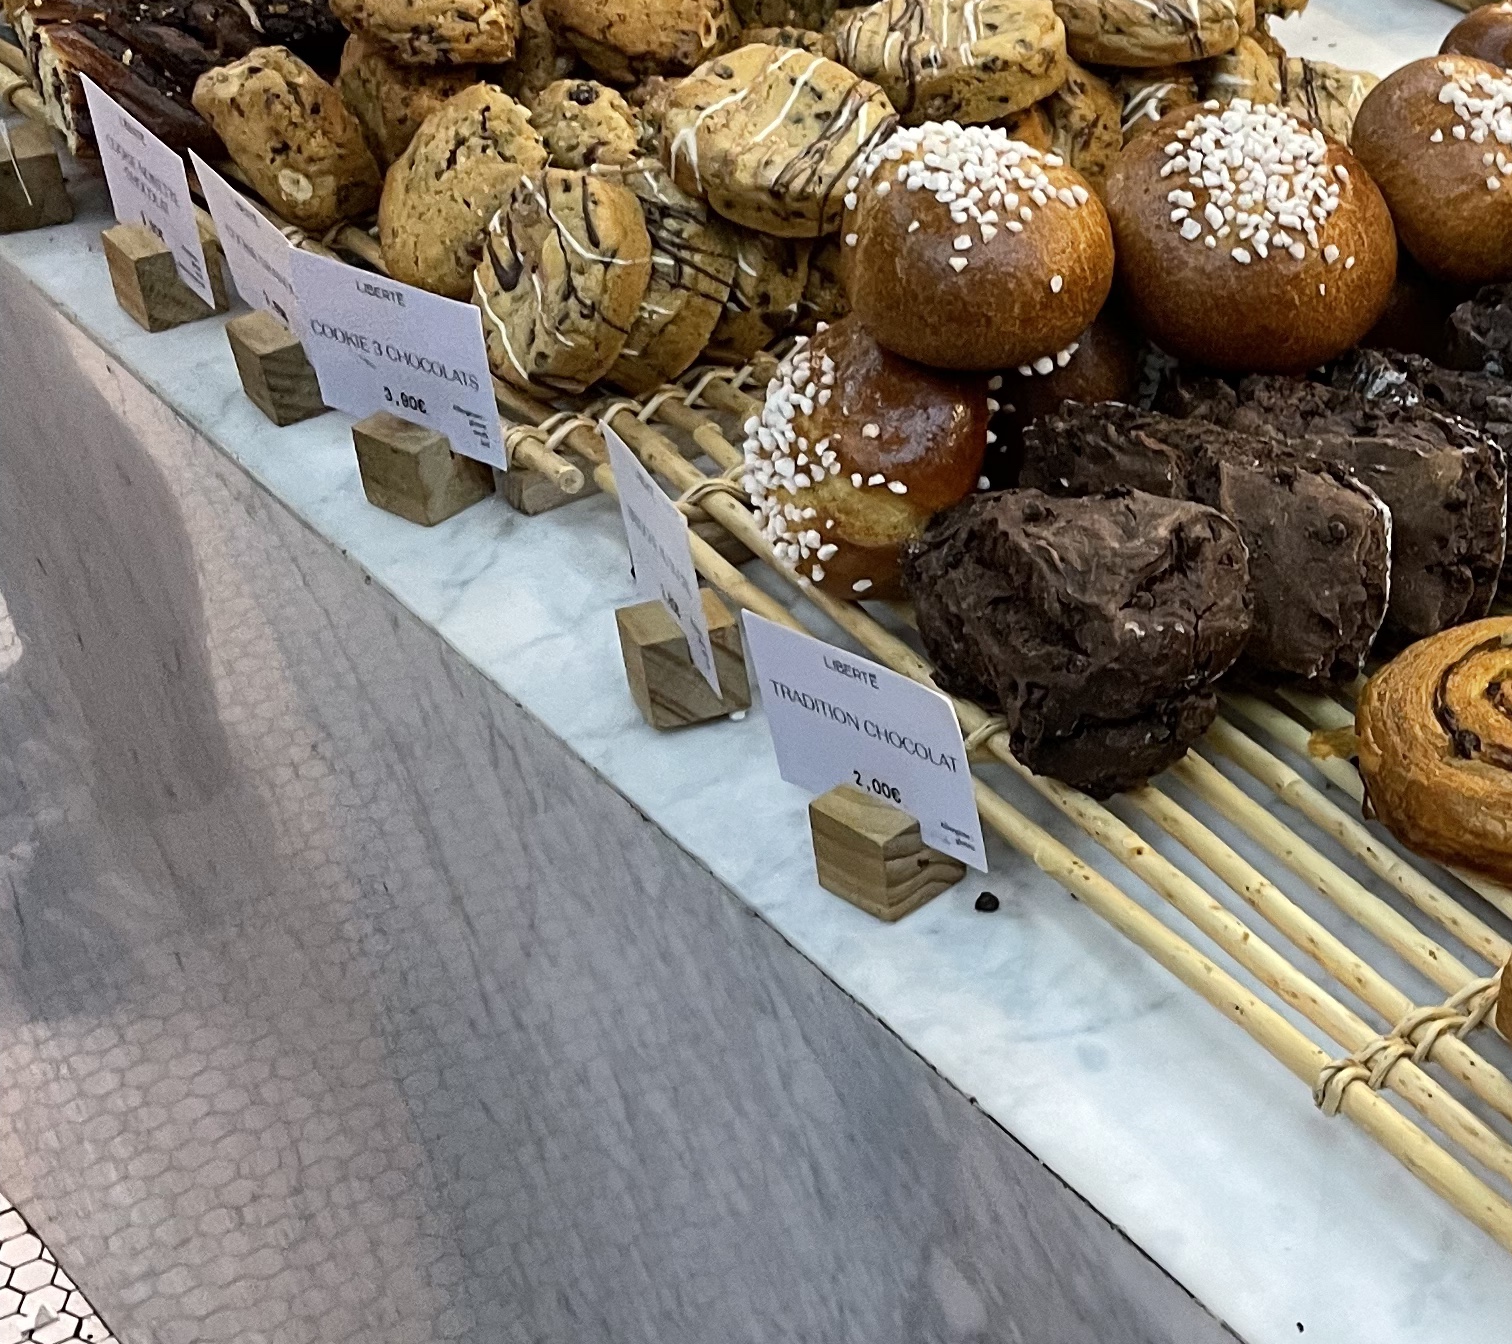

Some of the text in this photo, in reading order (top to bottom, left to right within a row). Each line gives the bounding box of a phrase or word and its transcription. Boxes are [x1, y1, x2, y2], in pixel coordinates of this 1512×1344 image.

[310, 318, 370, 354] COOKIE
[373, 340, 383, 357] 3
[385, 345, 480, 392] CHOCOLATS
[769, 678, 959, 773] TRADITION CHOCOLAT
[852, 769, 902, 804] 2,00€
